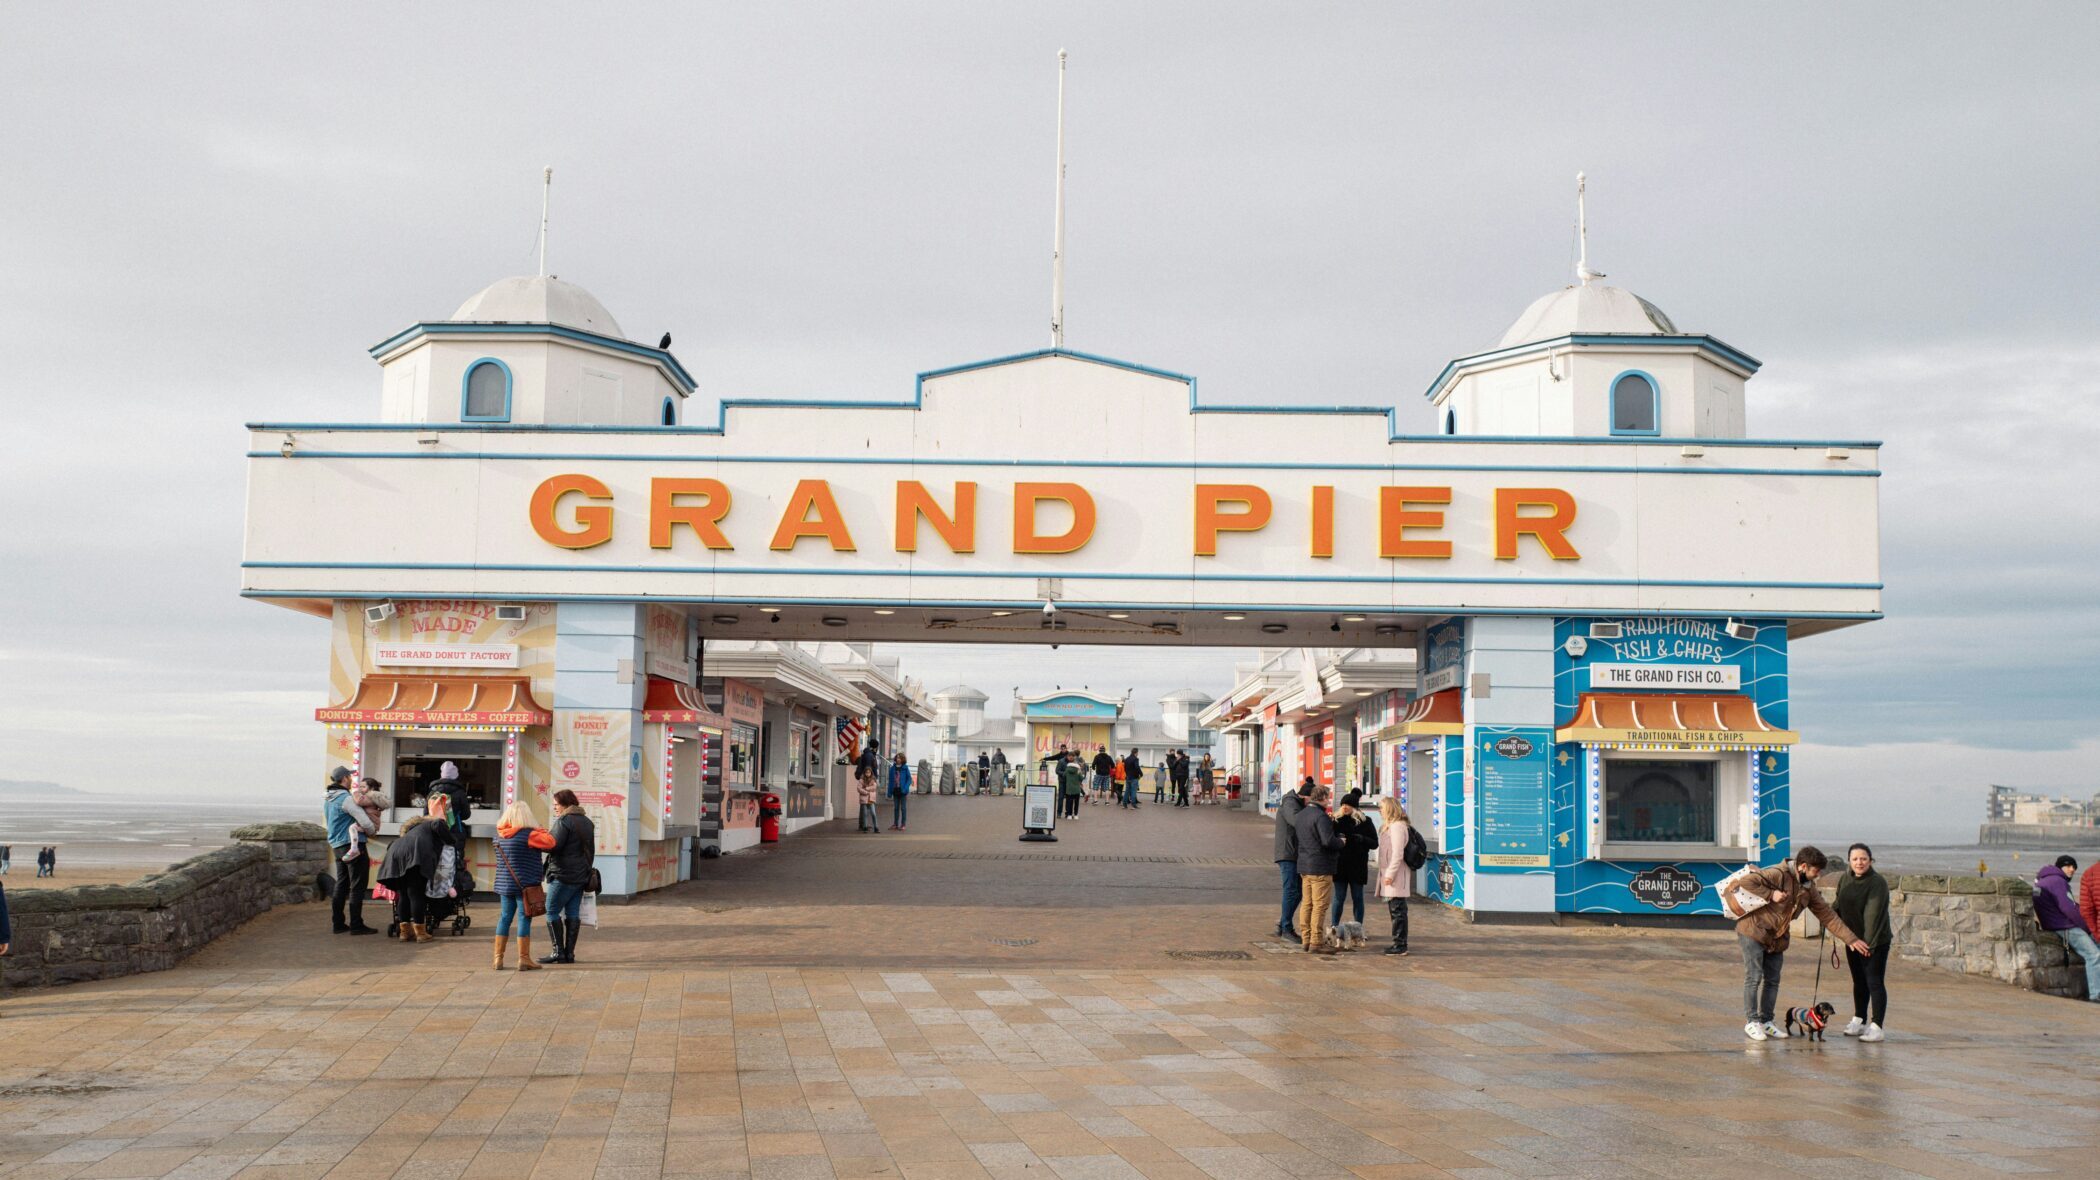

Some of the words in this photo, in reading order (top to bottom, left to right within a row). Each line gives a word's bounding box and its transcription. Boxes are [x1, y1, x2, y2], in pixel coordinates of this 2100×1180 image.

[529, 473, 1096, 554] GRAND
[1194, 484, 1582, 560] PIER
[395, 600, 496, 621] FRESHLY
[412, 616, 477, 635] MADE
[435, 651, 466, 659] DONUT
[470, 652, 512, 660] FACTORY
[1614, 640, 1651, 660] FISH
[1657, 639, 1667, 657] &
[1674, 640, 1723, 663] CHIPS
[1610, 669, 1631, 682] THE
[1635, 669, 1673, 682] GRAND
[1677, 670, 1702, 683] FISH
[1706, 670, 1724, 683] CO.
[319, 710, 363, 720] DONUTS
[374, 711, 414, 721] CREPES
[426, 712, 477, 722] WAFFLES
[489, 712, 529, 722] COFFEE
[574, 722, 609, 730] DONUT
[1627, 731, 1682, 741] TRADITIONAL
[1686, 732, 1705, 741] FISH
[1708, 732, 1714, 741] &
[1717, 732, 1744, 742] CHIPS
[1660, 872, 1672, 880] THE
[1638, 880, 1669, 891] GRAND
[1672, 881, 1693, 891] FISH
[1661, 891, 1672, 899] CO.
